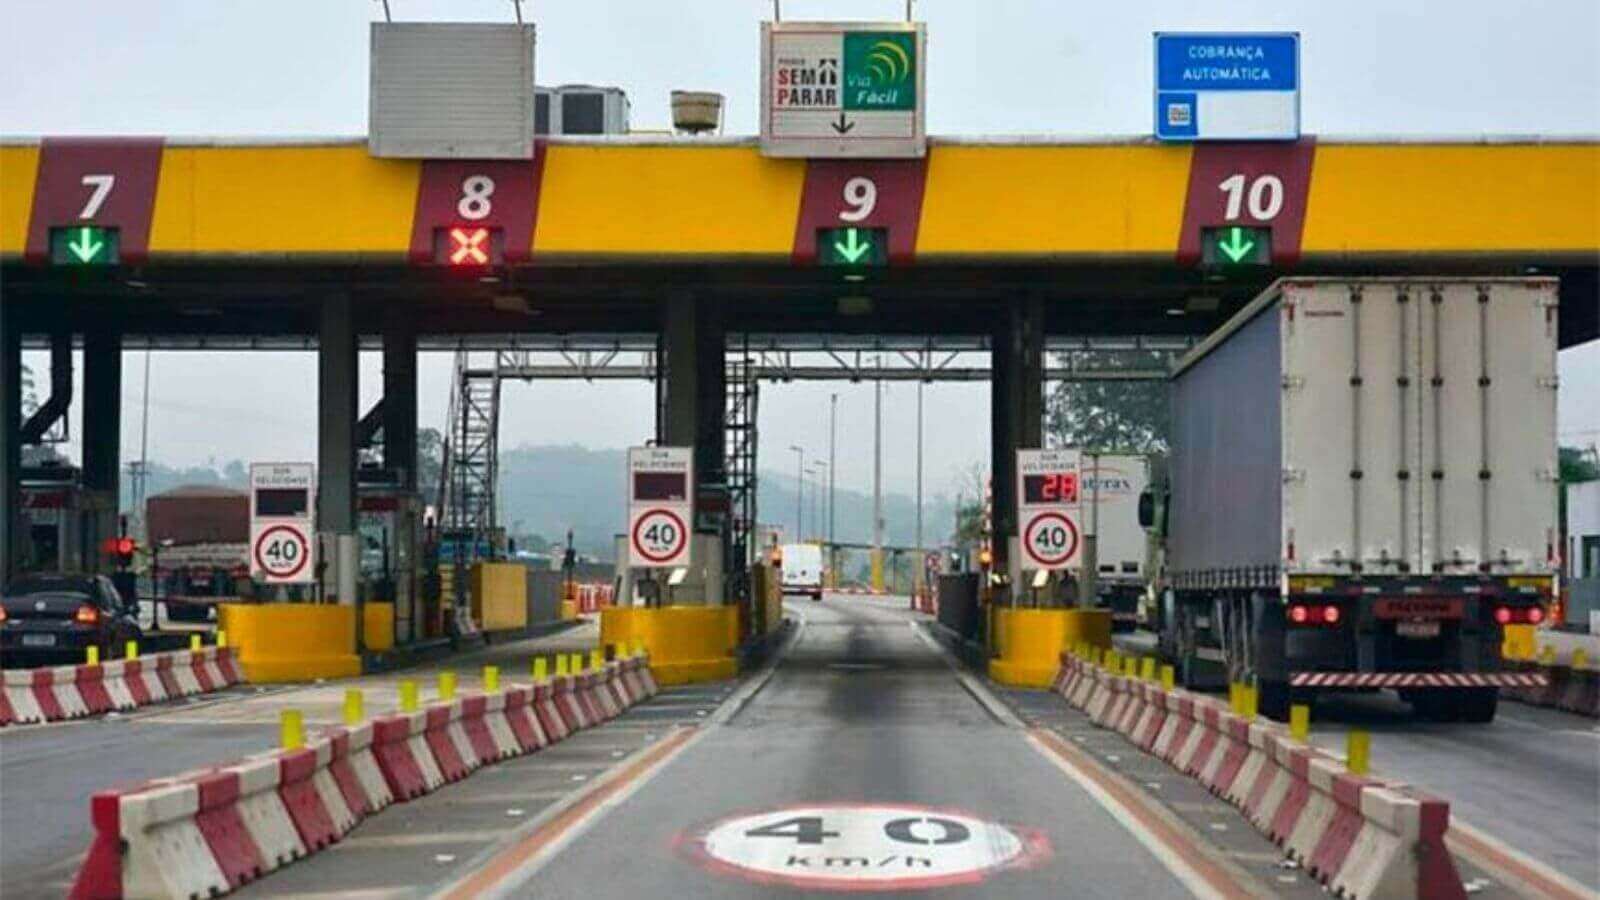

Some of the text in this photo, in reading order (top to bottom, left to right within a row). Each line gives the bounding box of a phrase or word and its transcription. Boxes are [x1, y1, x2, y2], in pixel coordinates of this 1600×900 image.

[1188, 45, 1264, 60] COBRANÇA
[778, 68, 816, 85] SEM
[848, 73, 871, 87] Via
[1183, 64, 1271, 80] AUTOMÁTICA
[778, 88, 837, 105] PARAR
[80, 175, 115, 219] 7
[458, 175, 495, 220] 8
[839, 176, 877, 221] 9
[1218, 174, 1284, 221] 10
[644, 523, 676, 545] 40
[1035, 526, 1067, 548] 40
[266, 539, 298, 561] 40
[785, 854, 933, 868] km/h
